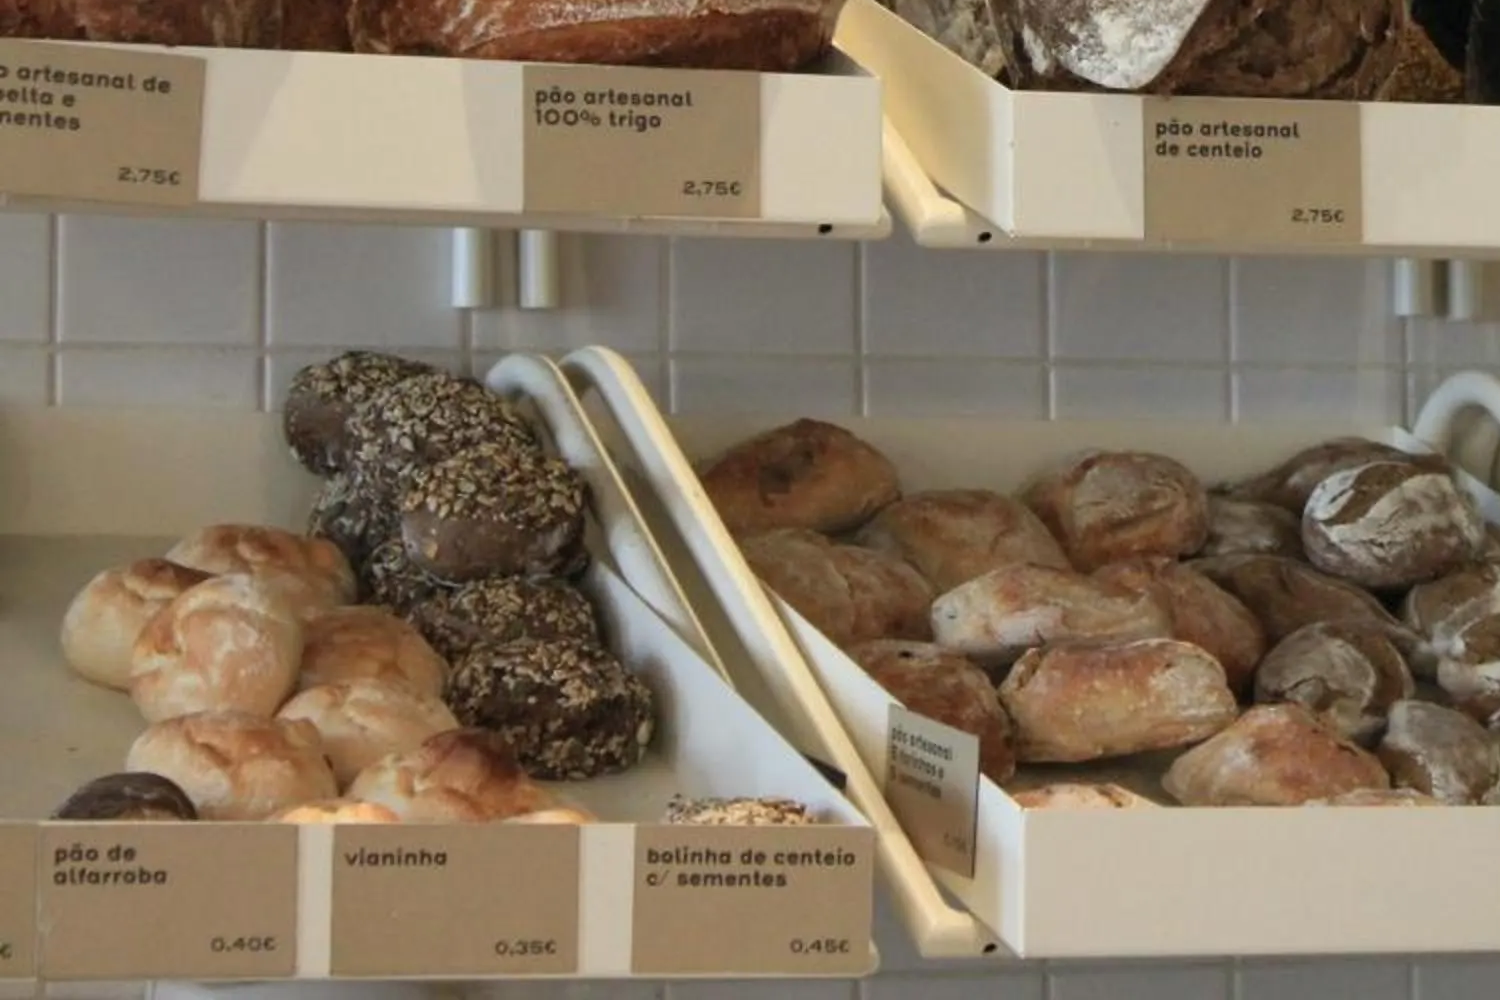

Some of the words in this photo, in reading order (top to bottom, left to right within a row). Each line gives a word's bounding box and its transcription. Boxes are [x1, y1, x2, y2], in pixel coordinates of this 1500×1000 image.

[15, 65, 136, 90] artesanal
[142, 75, 172, 95] de
[61, 94, 76, 108] e
[534, 85, 576, 107] pão
[583, 88, 693, 108] artesanal
[534, 105, 602, 127] 100%
[608, 109, 662, 133] trigo
[1155, 118, 1194, 140] pão
[1199, 121, 1300, 139] artesanal
[1155, 140, 1180, 157] de
[1186, 141, 1263, 159] centeio
[117, 166, 181, 186] 2,75€
[682, 180, 742, 197] 2,75€
[1291, 208, 1345, 224] 2,75€
[54, 842, 100, 866] pão
[106, 844, 137, 862] de
[344, 847, 448, 867] vianinha
[646, 845, 732, 865] bolinha
[739, 848, 767, 866] de
[773, 847, 856, 867] centeio
[53, 866, 168, 886] alfarroba
[645, 870, 669, 887] c/
[677, 870, 788, 888] sementes
[210, 936, 276, 953] 0,40€
